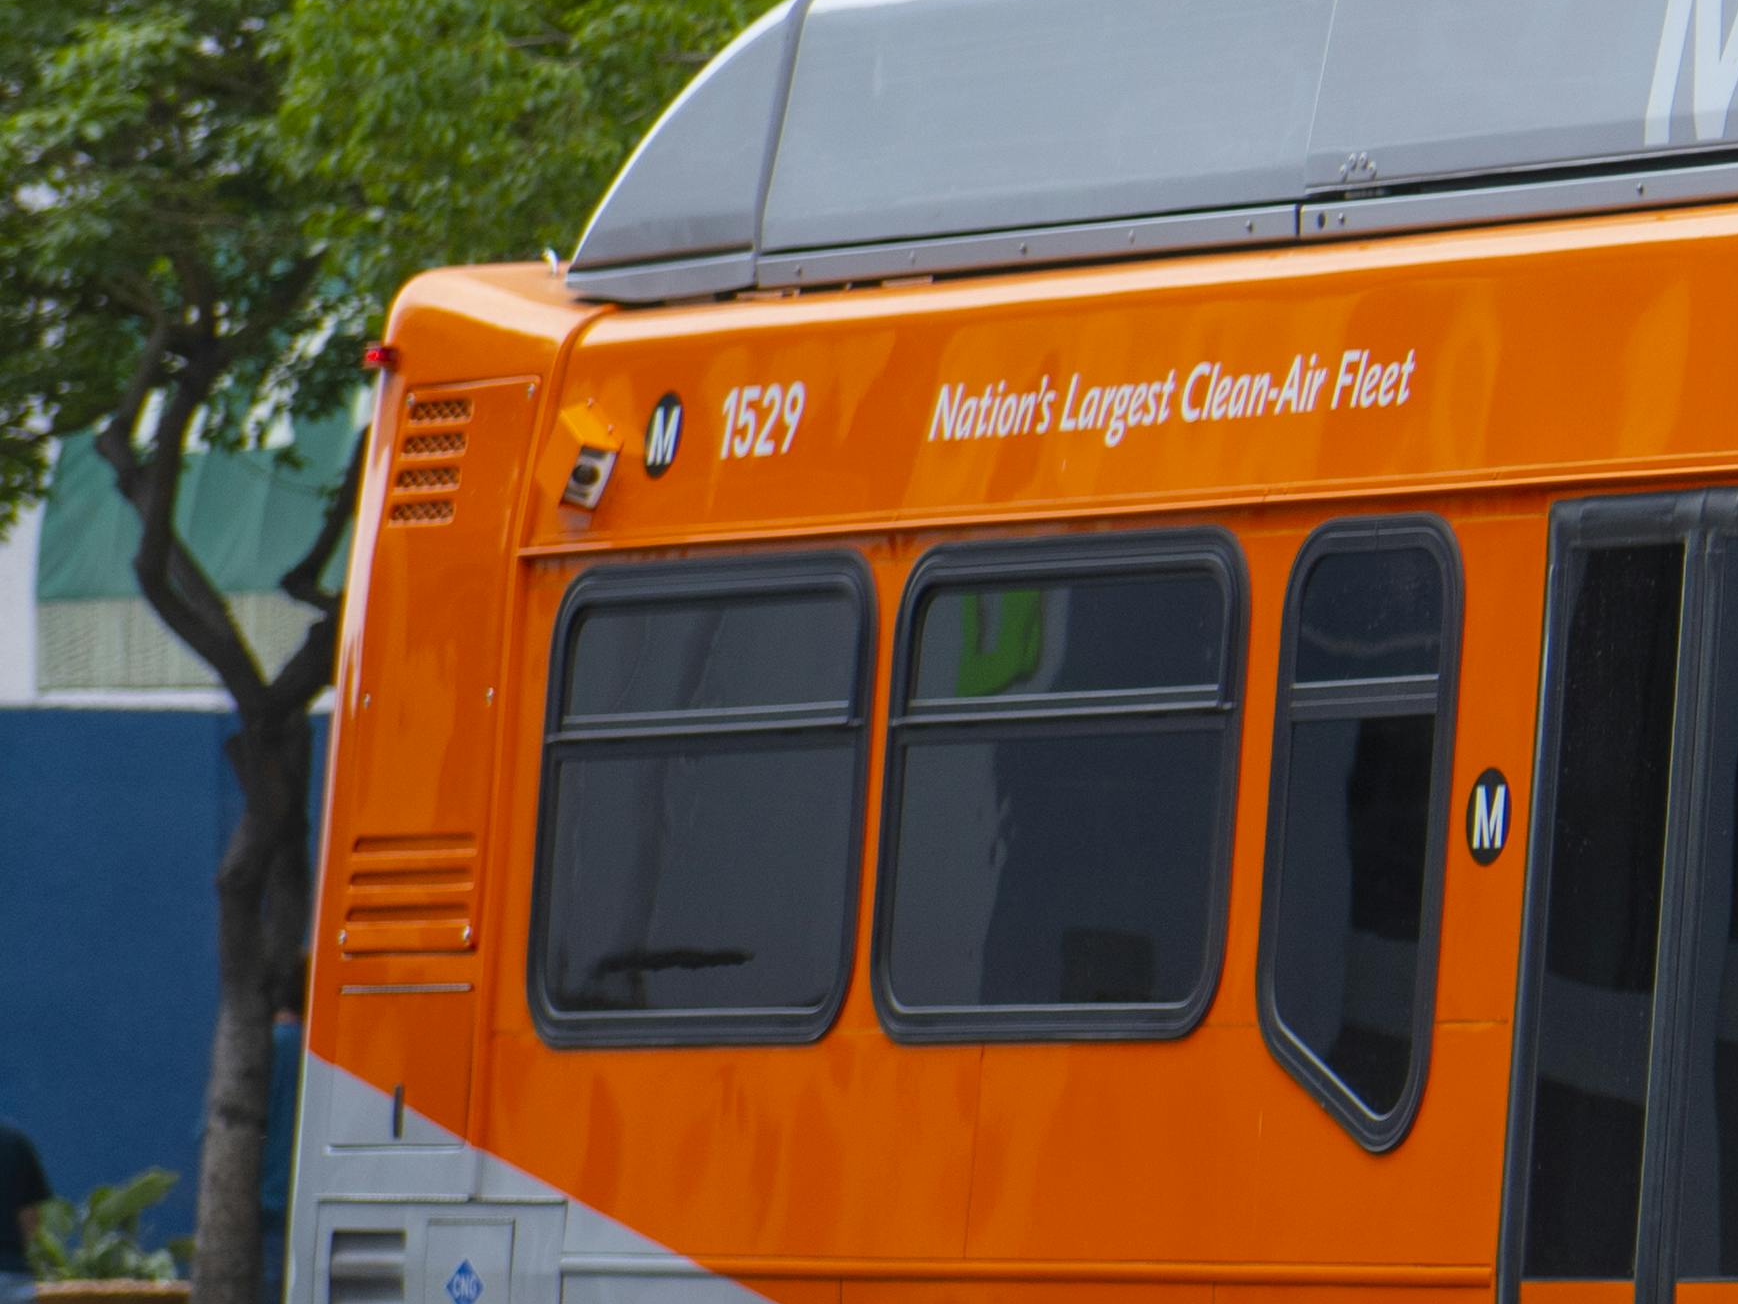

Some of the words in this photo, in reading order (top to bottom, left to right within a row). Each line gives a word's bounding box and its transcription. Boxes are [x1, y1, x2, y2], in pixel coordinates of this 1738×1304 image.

[719, 380, 808, 460] 1529
[928, 374, 1056, 443] Nation's
[1058, 368, 1177, 448] Largest
[1180, 353, 1328, 423] Clean-Air
[1330, 348, 1417, 411] Fleet
